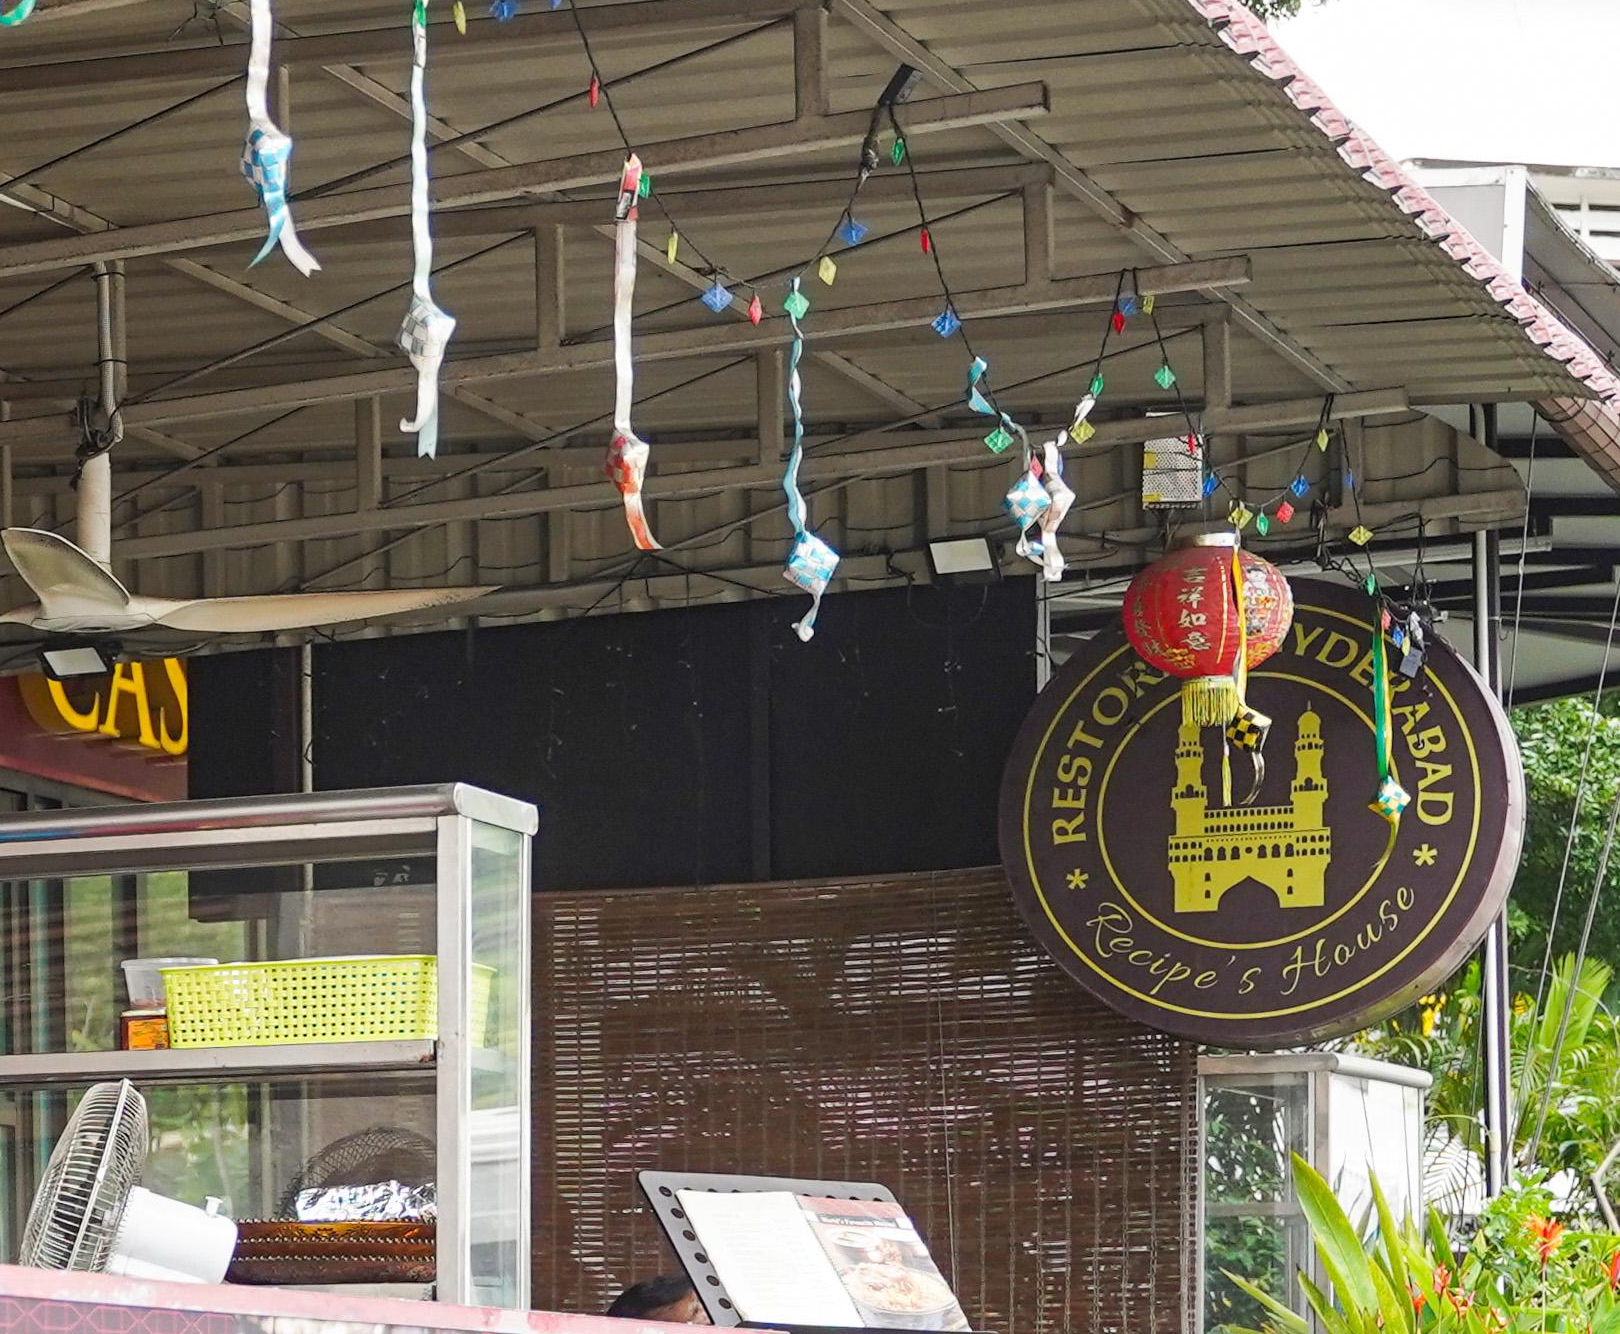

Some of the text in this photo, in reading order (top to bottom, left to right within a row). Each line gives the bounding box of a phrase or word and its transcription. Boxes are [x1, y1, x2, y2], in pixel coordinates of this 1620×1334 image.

[1051, 660, 1165, 845] RESTOR
[1086, 885, 1415, 996] Recipe's House
